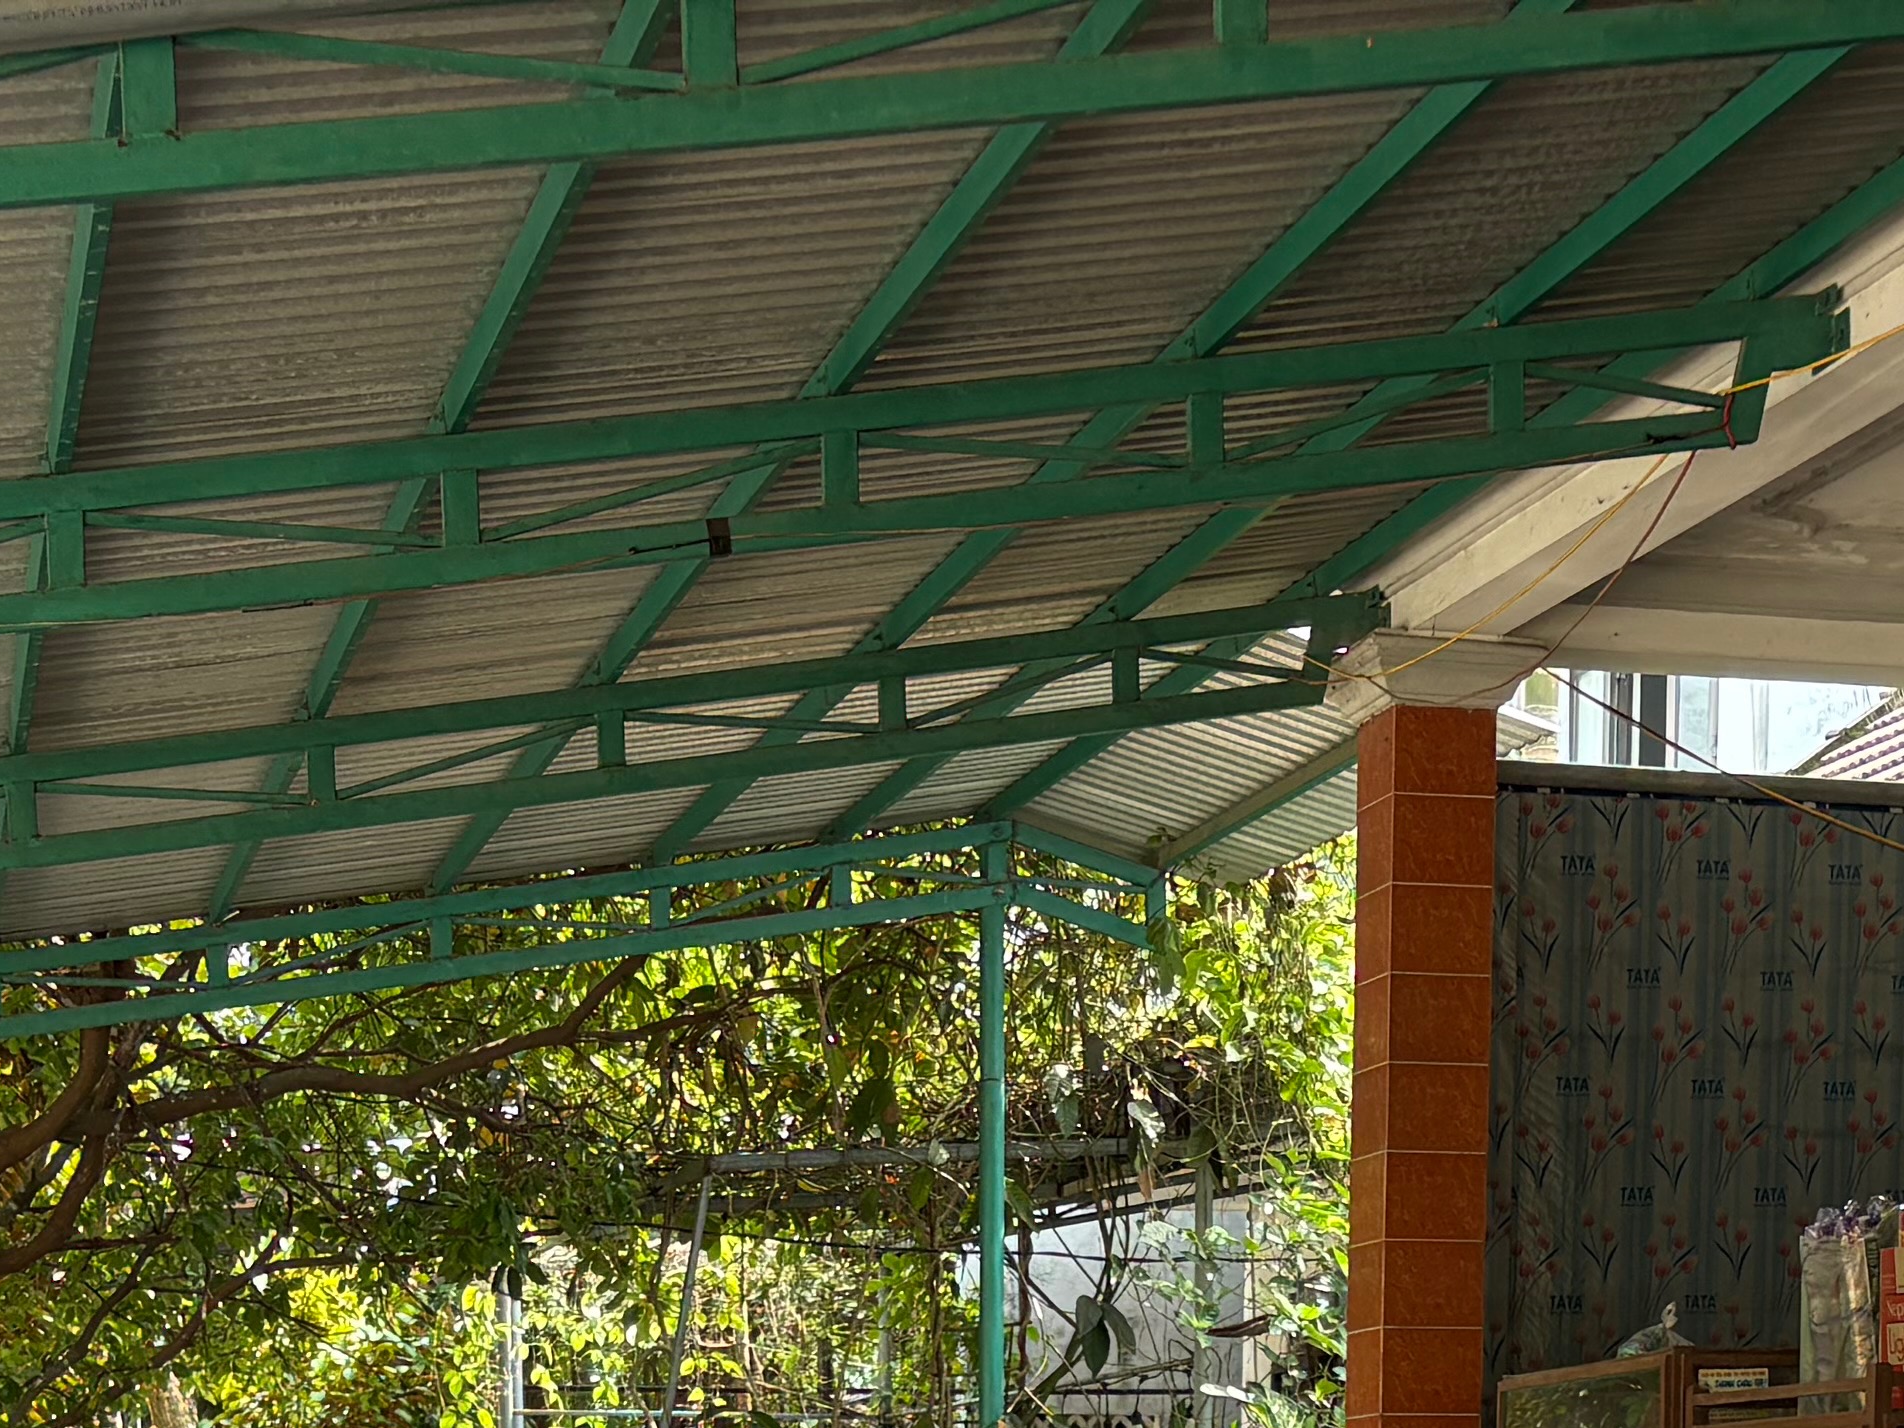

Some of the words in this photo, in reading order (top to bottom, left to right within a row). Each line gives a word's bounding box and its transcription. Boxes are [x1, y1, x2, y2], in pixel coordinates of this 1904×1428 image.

[1561, 856, 1595, 871] TATA
[1697, 860, 1729, 874] TATA
[1829, 865, 1860, 880] TATA
[1628, 969, 1659, 984] TATA
[1760, 972, 1792, 986] TATA
[1621, 1187, 1653, 1202] TATA
[1755, 1187, 1786, 1203] TATA
